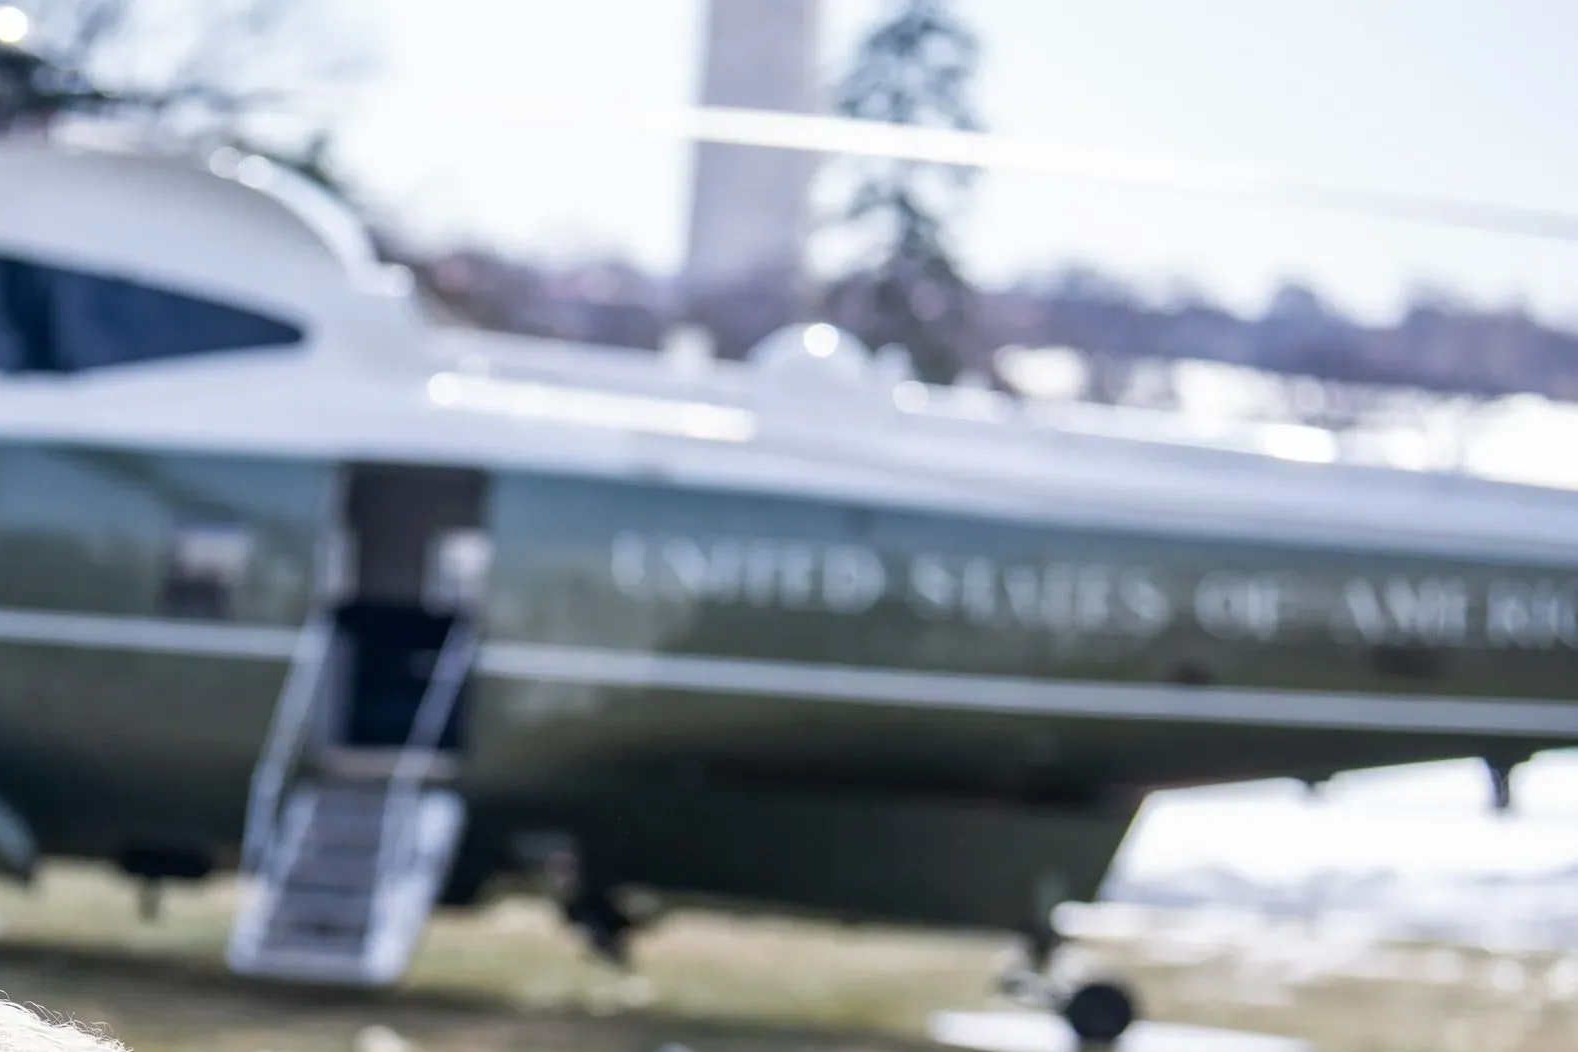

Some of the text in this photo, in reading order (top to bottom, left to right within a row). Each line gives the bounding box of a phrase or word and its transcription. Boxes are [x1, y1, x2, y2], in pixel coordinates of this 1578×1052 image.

[610, 532, 886, 615] UNITED
[906, 552, 1170, 638] STATES
[1193, 571, 1301, 641] OF
